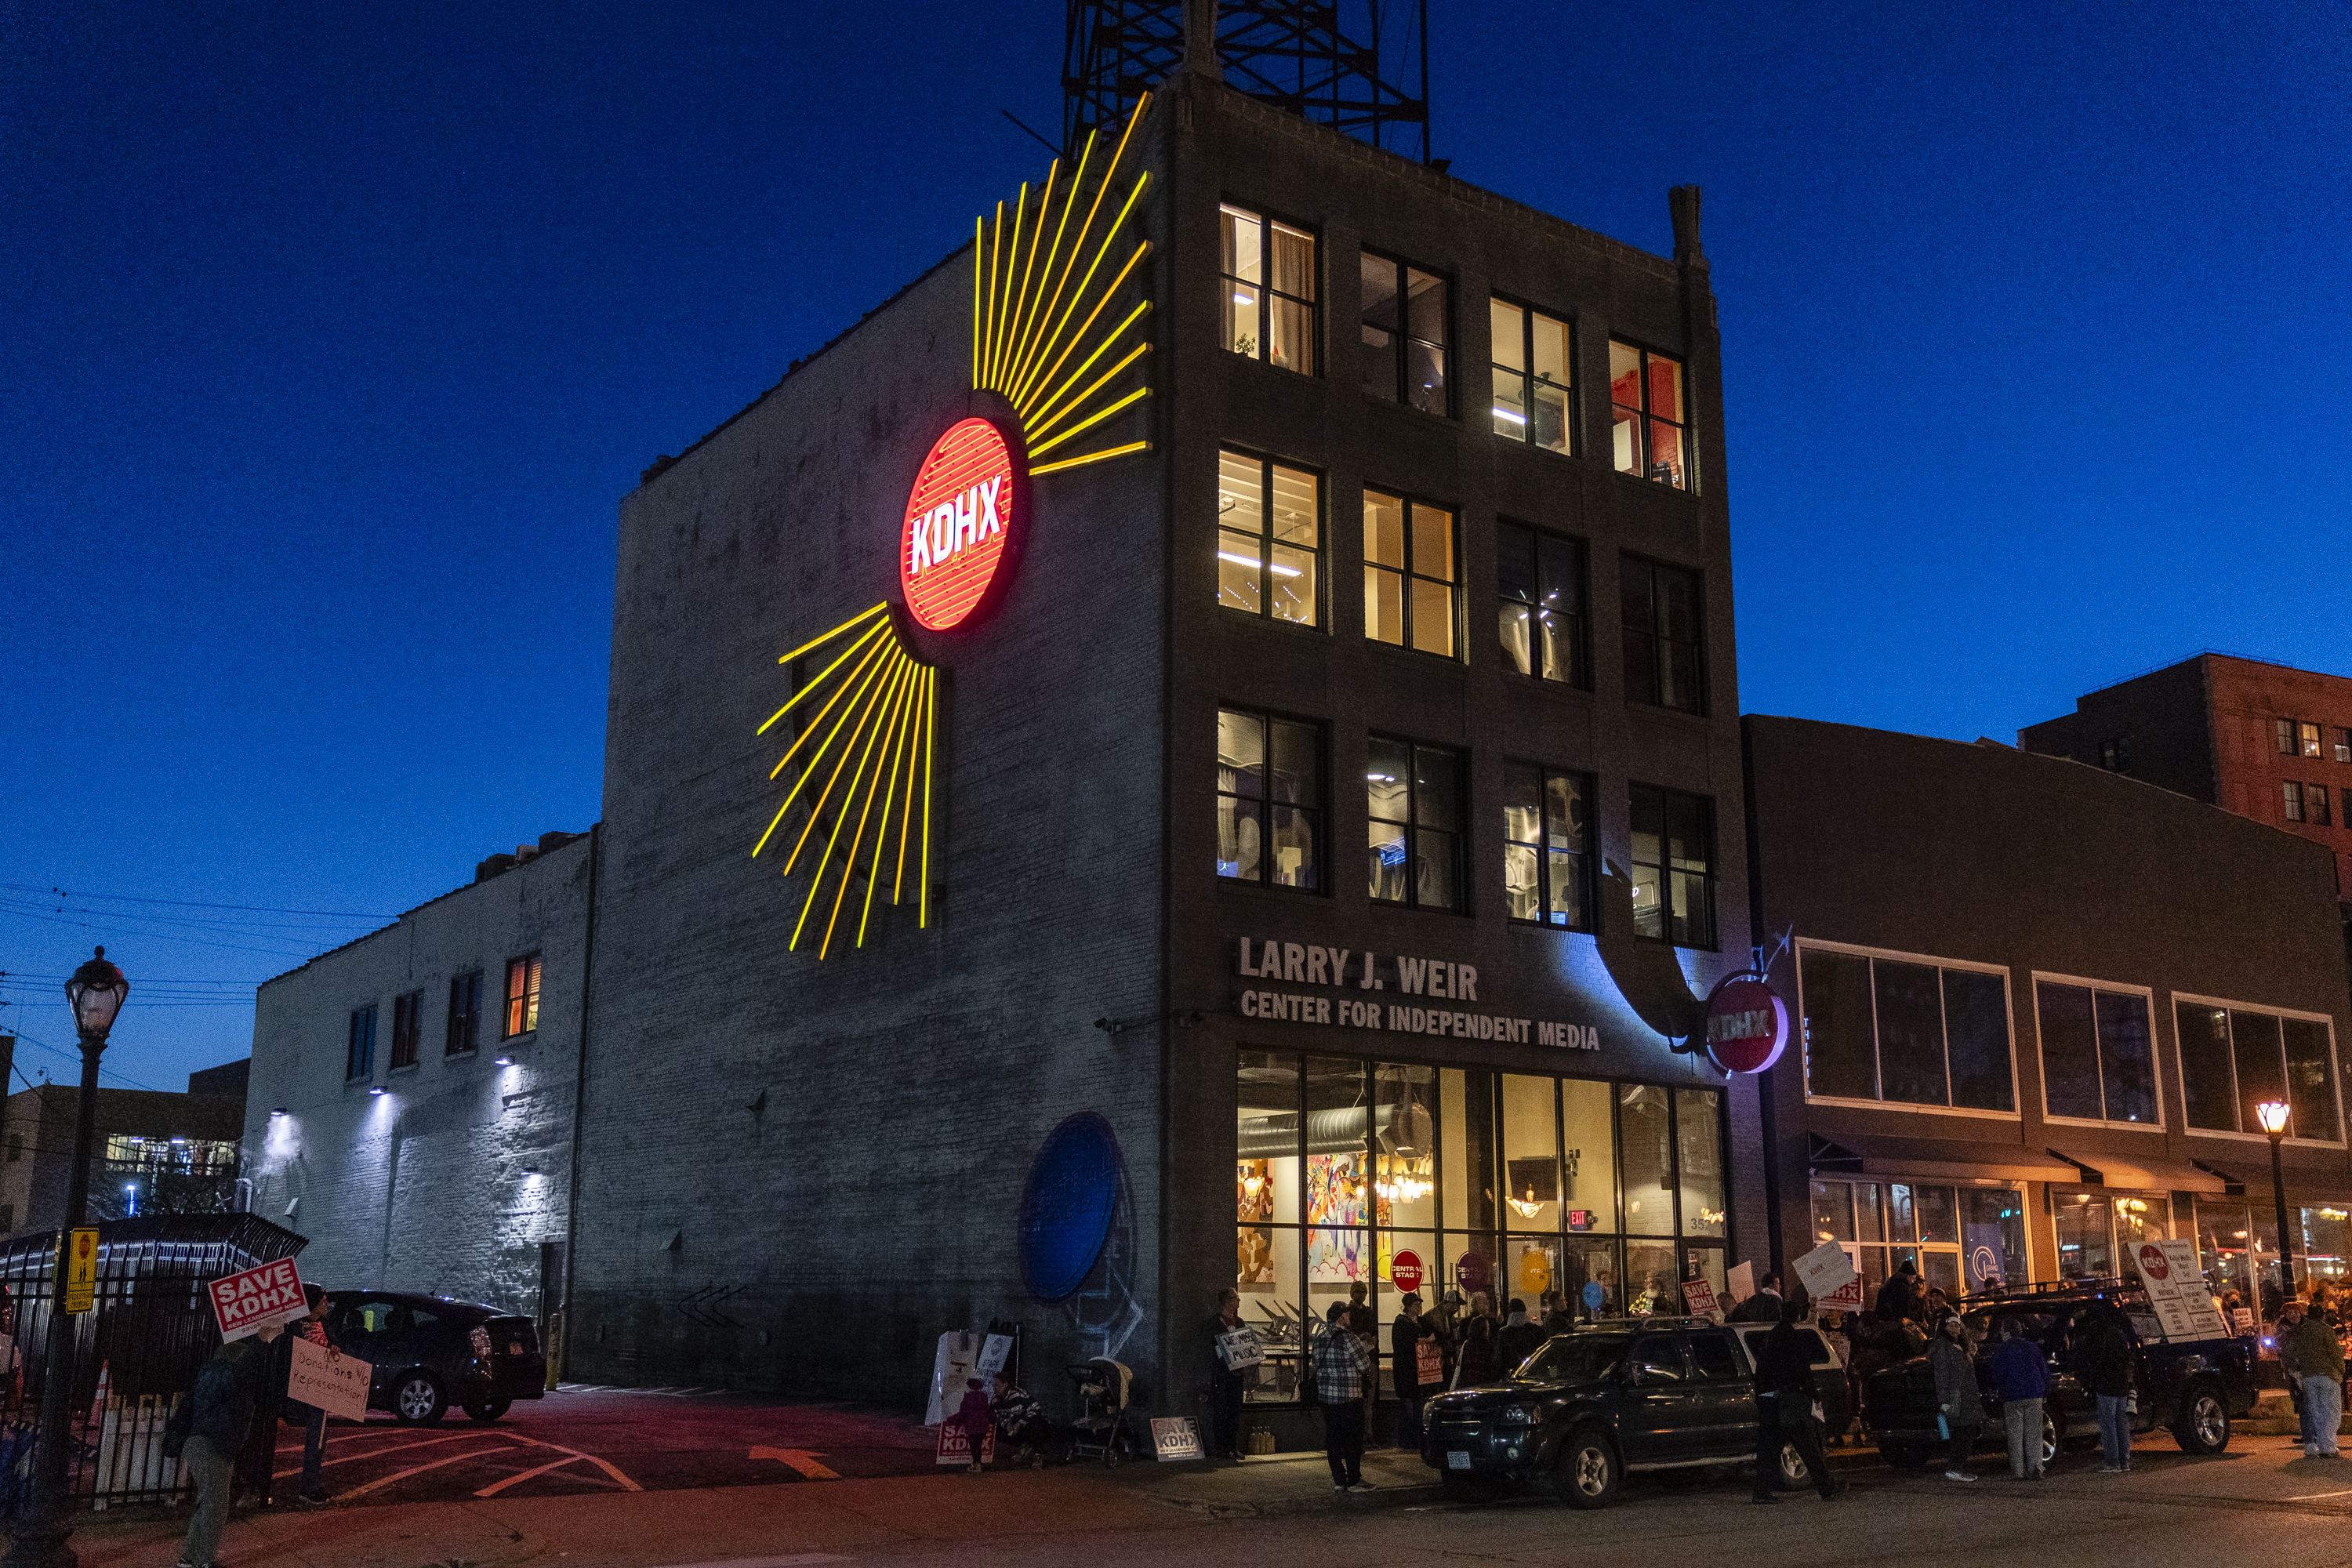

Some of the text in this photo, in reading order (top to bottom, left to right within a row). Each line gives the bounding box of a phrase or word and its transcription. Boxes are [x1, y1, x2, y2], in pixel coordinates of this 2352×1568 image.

[911, 474, 1002, 575] KDHX
[1240, 936, 1478, 1001] LARRY J. WEIR
[1241, 989, 1600, 1051] CENTER FOR INDEPENDENT MEDIA
[1707, 1010, 1769, 1044] KDHX
[1571, 1211, 1584, 1225] EXIT
[216, 1263, 294, 1304] SAVE
[1685, 1282, 1711, 1298] SAVE
[1835, 1287, 1858, 1299] HX
[222, 1282, 299, 1323] KDHX
[1689, 1295, 1717, 1309] KDHX
[227, 1319, 243, 1330] NEW
[244, 1306, 283, 1324] LEADERSHIP
[1223, 1332, 1254, 1347] WE MISS
[1232, 1345, 1258, 1362] MUSIC
[982, 1359, 1000, 1369] STAFF
[1418, 1356, 1442, 1372] KDHX
[1156, 1419, 1197, 1435] SAVE
[1158, 1434, 1199, 1448] KDHX
